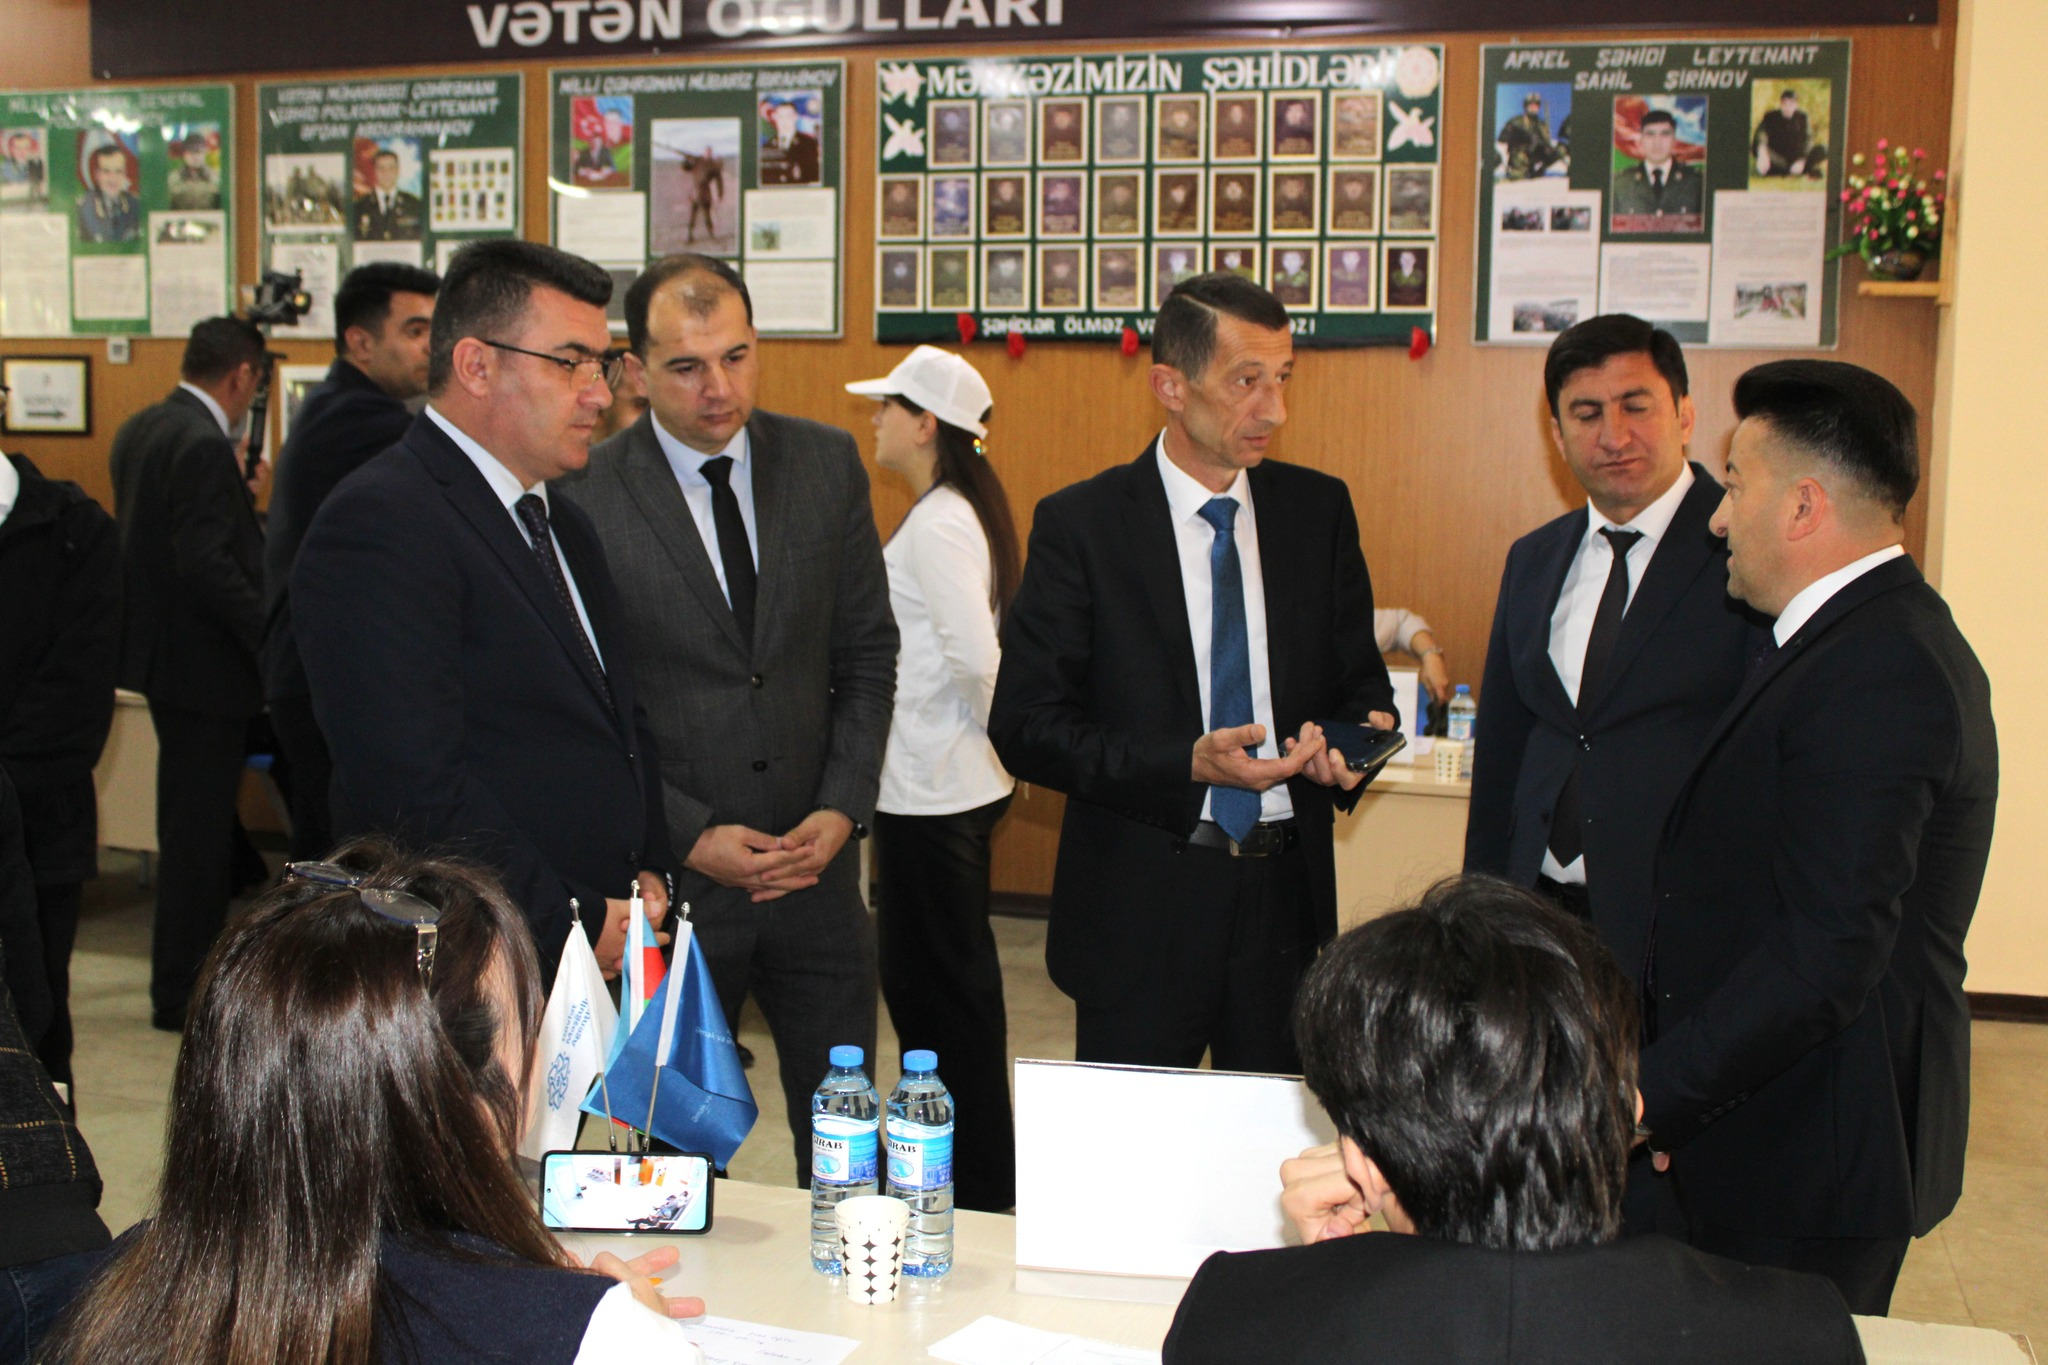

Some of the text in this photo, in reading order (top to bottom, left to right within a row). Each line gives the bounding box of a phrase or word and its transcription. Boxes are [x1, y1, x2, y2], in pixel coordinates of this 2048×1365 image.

[466, 0, 683, 48] VƏTƏN
[1504, 45, 1819, 70] APREL ŞƏHİDİ LEYTENANT
[926, 53, 1183, 98] MƏKƏZİMİZİN
[1574, 69, 1749, 91] SAHİL ŞİRİNOV
[1063, 314, 1125, 335] ÖLMƏZ
